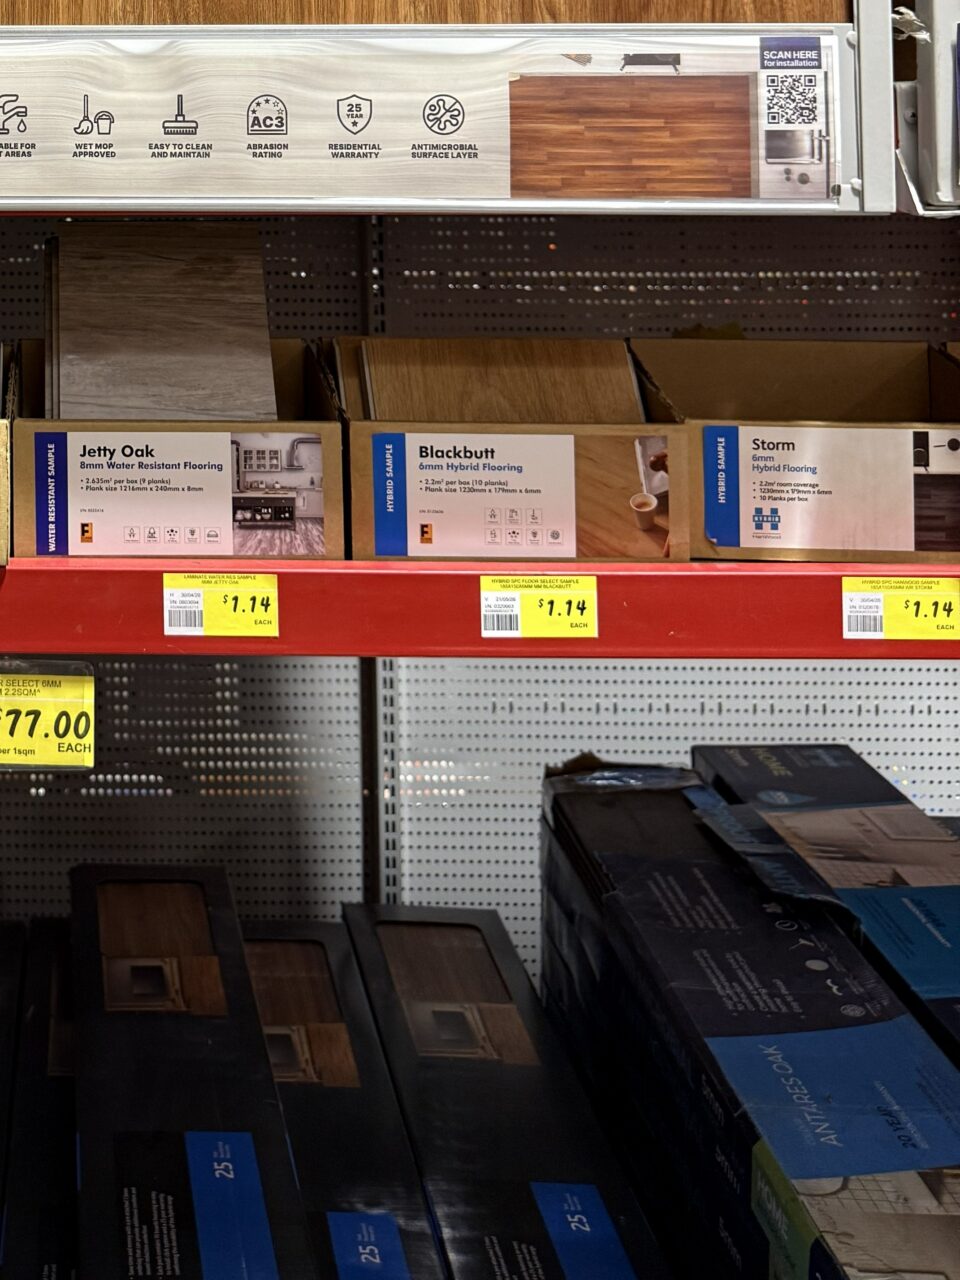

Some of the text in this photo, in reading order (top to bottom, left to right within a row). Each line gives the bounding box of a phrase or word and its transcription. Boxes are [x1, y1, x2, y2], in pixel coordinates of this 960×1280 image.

[763, 51, 819, 60] SCAN HERE
[775, 59, 819, 68] installation
[346, 104, 362, 113] 25
[250, 116, 285, 129] AC3
[20, 142, 37, 150] FOR
[75, 142, 114, 150] WET MOP
[148, 142, 170, 150] EASY
[172, 142, 184, 150] TO
[246, 143, 289, 151] ABRASION
[328, 143, 382, 151] RESIDENTIAL
[411, 143, 479, 151] ANTIMICROBIAL
[4, 150, 32, 158] AREAS
[72, 150, 116, 158] APPROVED
[150, 150, 167, 158] AND
[251, 151, 283, 159] RATING
[331, 151, 380, 159] WARRANTY
[411, 151, 479, 159] SURFACE LAYER
[752, 438, 796, 452] Storm
[79, 444, 156, 460] Jetty Oak
[419, 445, 496, 460] Blackbutt
[752, 453, 775, 463] 6mm
[80, 461, 224, 472] 8mm Water Resistant Flooring
[419, 462, 523, 473] 6mm Hybrid Flooring
[717, 437, 726, 504] HYBRID SAMPLE
[752, 463, 818, 475] Hybrid Flooring
[385, 443, 395, 513] HYBRID SAMPLE
[48, 477, 56, 522] RESISTANT
[48, 524, 56, 553] WATER
[223, 594, 272, 614] $1.14
[538, 598, 587, 617] $1.14
[904, 599, 955, 619] $1.14
[5, 679, 40, 688] SELECT
[41, 680, 62, 689] 6MM
[13, 746, 36, 756] 1sqm
[57, 742, 92, 753] EACH
[214, 1161, 235, 1179] 25
[567, 1214, 591, 1233] 25
